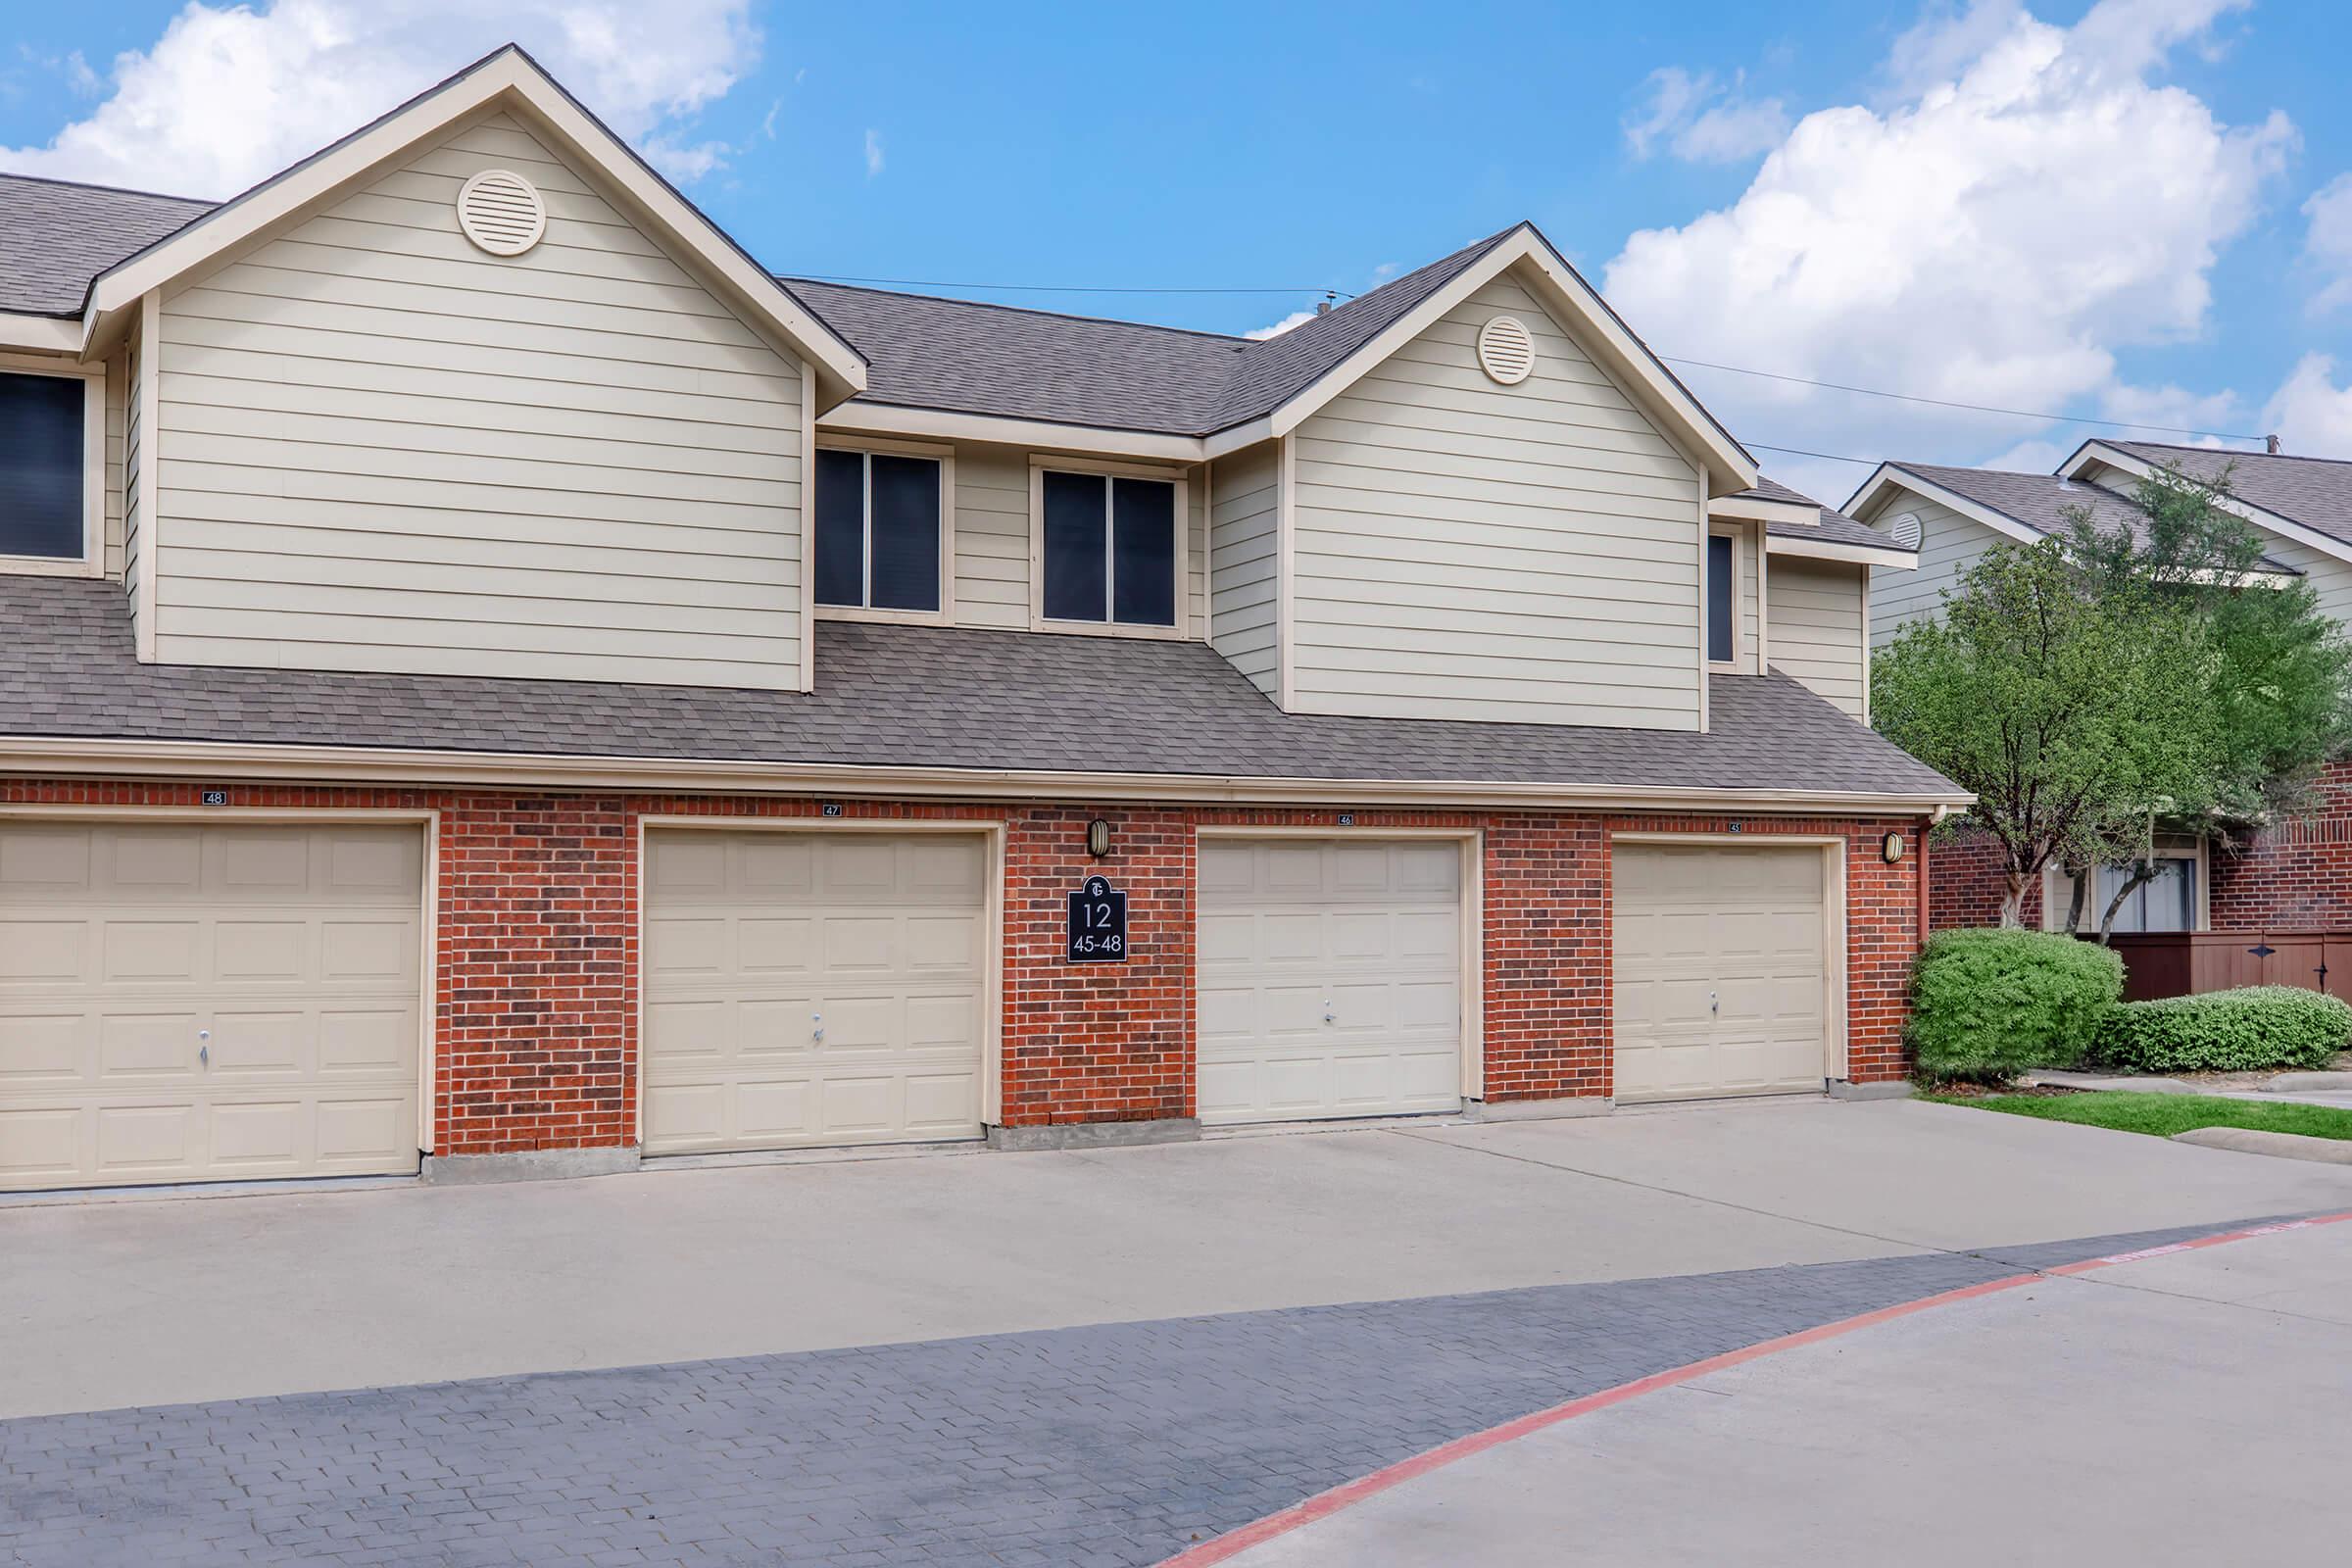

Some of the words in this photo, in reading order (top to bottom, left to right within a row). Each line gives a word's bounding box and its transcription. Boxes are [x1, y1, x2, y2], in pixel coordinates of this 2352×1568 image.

[207, 793, 221, 804] 48
[826, 806, 838, 815] 47
[1341, 815, 1351, 824] 46
[1084, 904, 1111, 927] 12
[1073, 935, 1122, 953] 45-48
